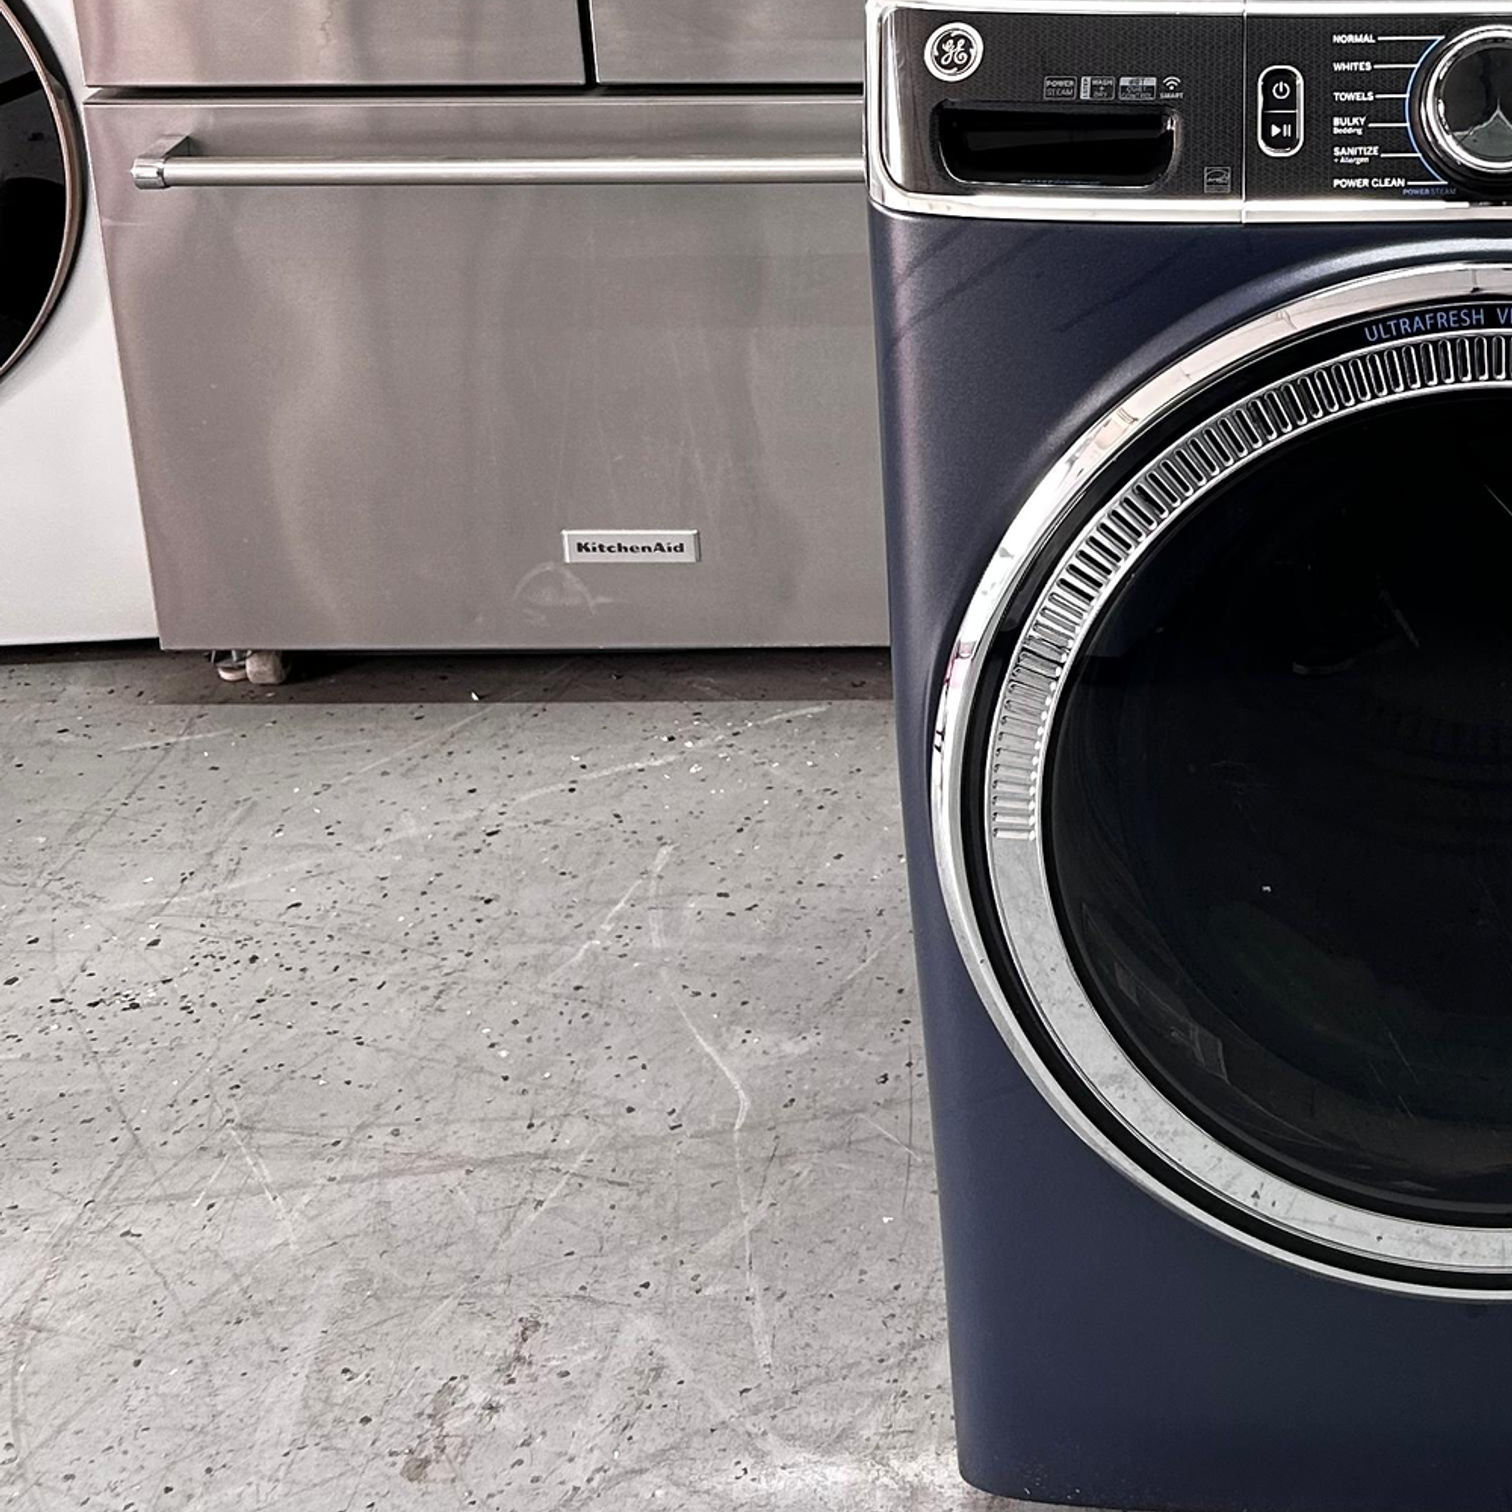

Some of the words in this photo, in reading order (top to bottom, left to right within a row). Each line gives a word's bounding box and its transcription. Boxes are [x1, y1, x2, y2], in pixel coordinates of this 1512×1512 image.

[1333, 34, 1375, 43] NORMAL
[1333, 61, 1372, 71] WHITES
[1047, 88, 1073, 96] STEAM
[1333, 91, 1374, 101] TOWELS
[1333, 116, 1367, 127] BULKY
[1333, 146, 1379, 156] SANITIZE
[1333, 178, 1369, 188] POWER
[1371, 178, 1406, 188] CLEAN
[1364, 308, 1485, 342] ULTRAFRESH
[576, 542, 685, 554] KitchenAid
